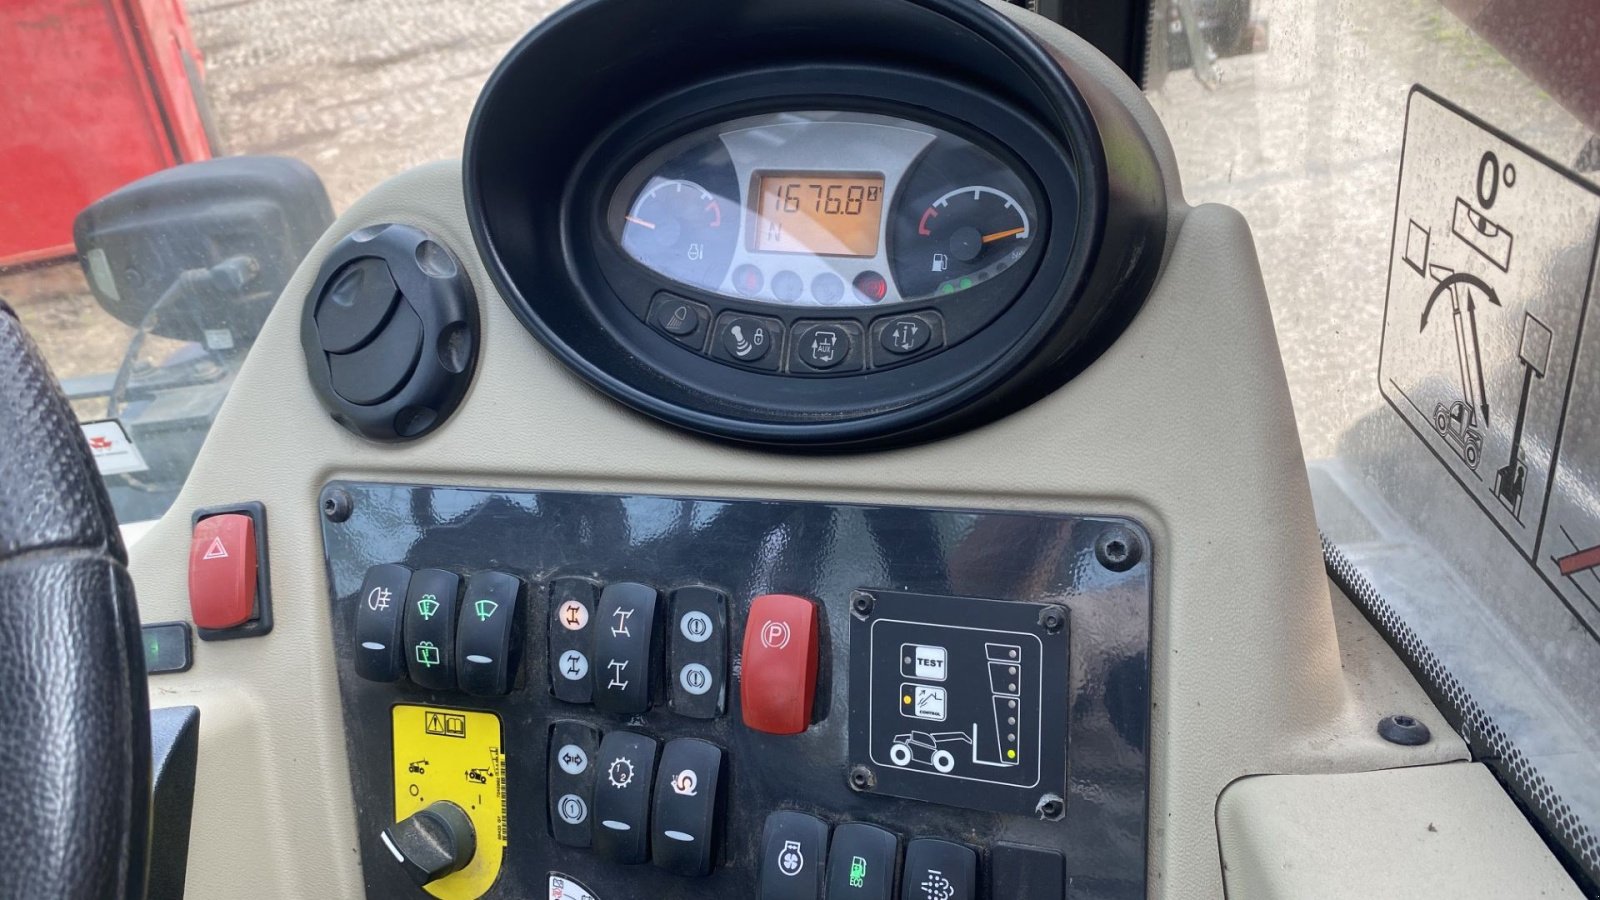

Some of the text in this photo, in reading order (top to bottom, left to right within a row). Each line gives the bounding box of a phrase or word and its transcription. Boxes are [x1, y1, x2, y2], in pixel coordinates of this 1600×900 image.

[817, 344, 831, 353] AUX
[768, 625, 782, 643] P
[917, 657, 944, 669] TEST
[619, 772, 627, 782] 2
[849, 875, 863, 888] ECO
